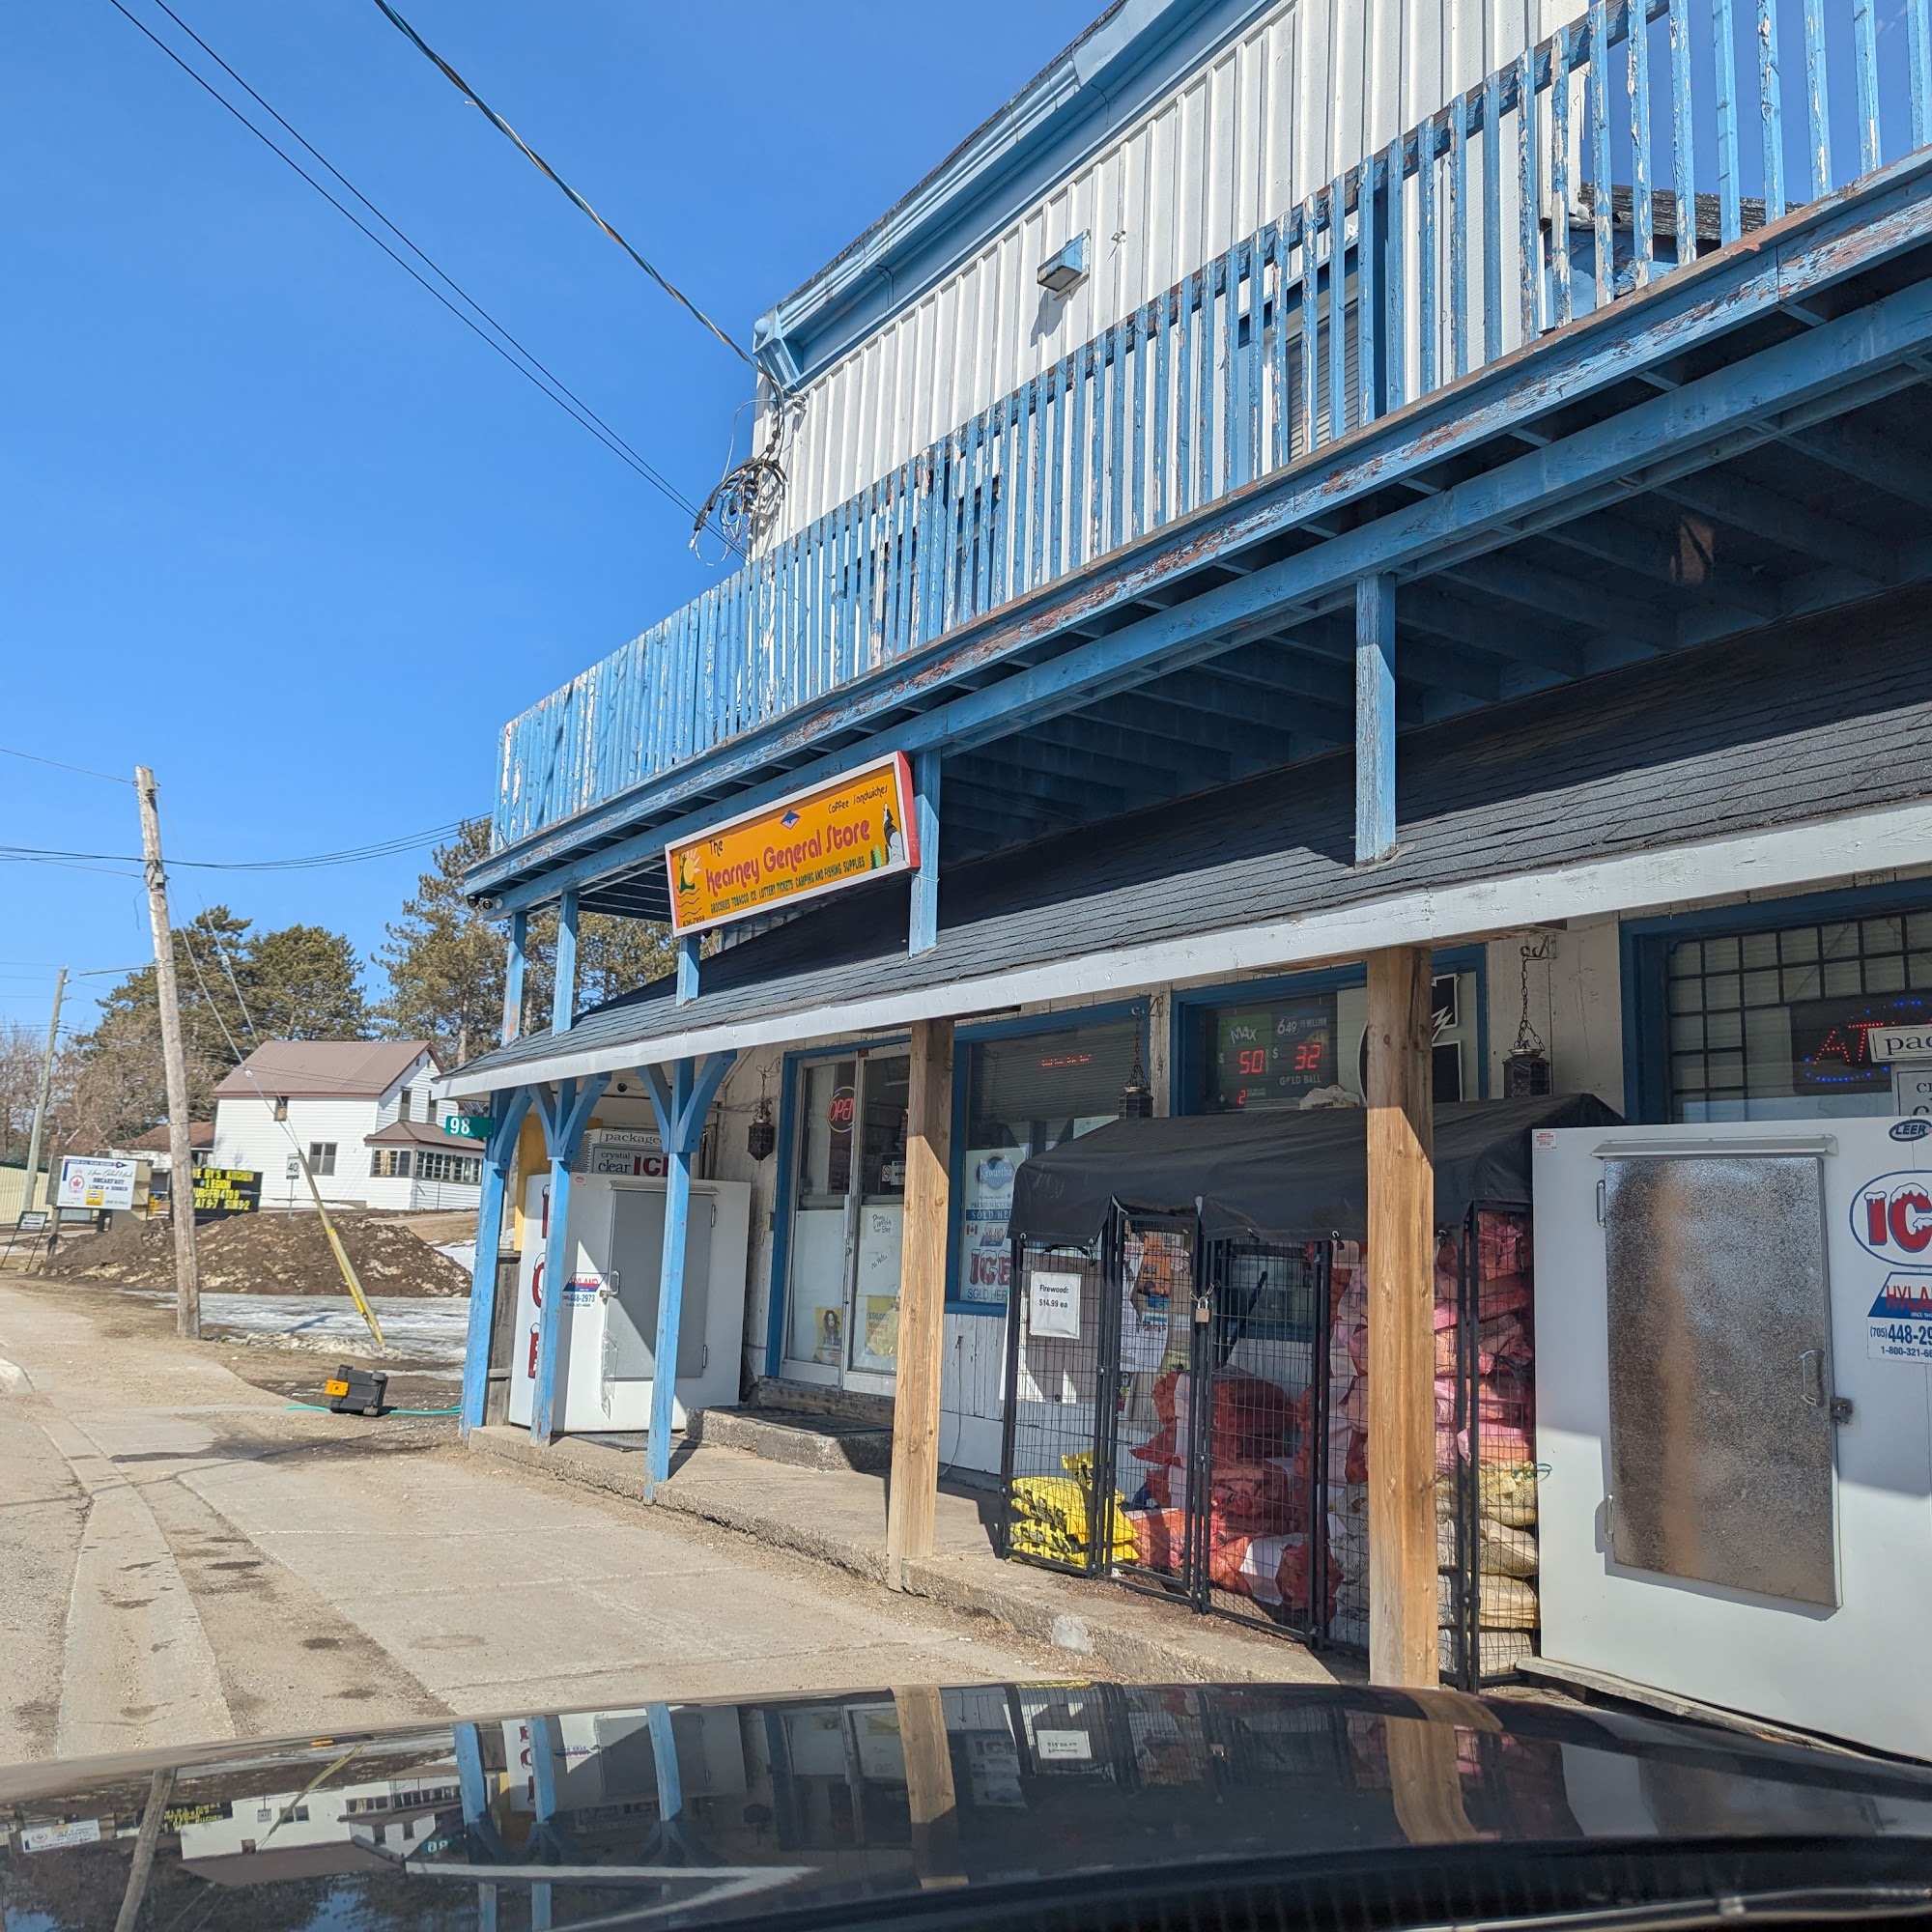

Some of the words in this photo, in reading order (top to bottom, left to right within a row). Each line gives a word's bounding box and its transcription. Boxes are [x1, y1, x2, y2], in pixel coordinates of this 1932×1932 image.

[828, 800, 849, 814] Coffee
[853, 785, 888, 805] Sandwiches
[709, 839, 724, 857] The
[705, 858, 760, 897] Kearney
[763, 829, 823, 872] General
[826, 820, 870, 853] Store
[710, 898, 730, 915] GROCERIES
[731, 893, 749, 907] TOBACCO
[776, 879, 794, 892] TICKETS
[795, 871, 814, 889] CAMPING
[824, 863, 841, 878] FISHING
[843, 856, 865, 872] SUPPLIES
[1231, 1026, 1257, 1044] MAX
[1239, 1049, 1265, 1074] 50
[1294, 1044, 1321, 1070] 32
[449, 1117, 470, 1135] 98
[1895, 1124, 1927, 1135] LEER
[605, 1133, 664, 1145] package
[601, 1151, 631, 1160] crystal
[288, 1162, 298, 1173] 40
[598, 1159, 631, 1174] clear
[980, 1166, 1012, 1179] Kawartha
[971, 1210, 994, 1220] SOLD
[970, 1248, 1011, 1286] ICE
[968, 1288, 989, 1300] SOLD
[991, 1290, 1009, 1301] HER
[1039, 1284, 1069, 1294] Firewood:
[1038, 1298, 1059, 1308] $14.99
[1886, 1285, 1932, 1312] HYLA
[1869, 1325, 1888, 1340] (705)
